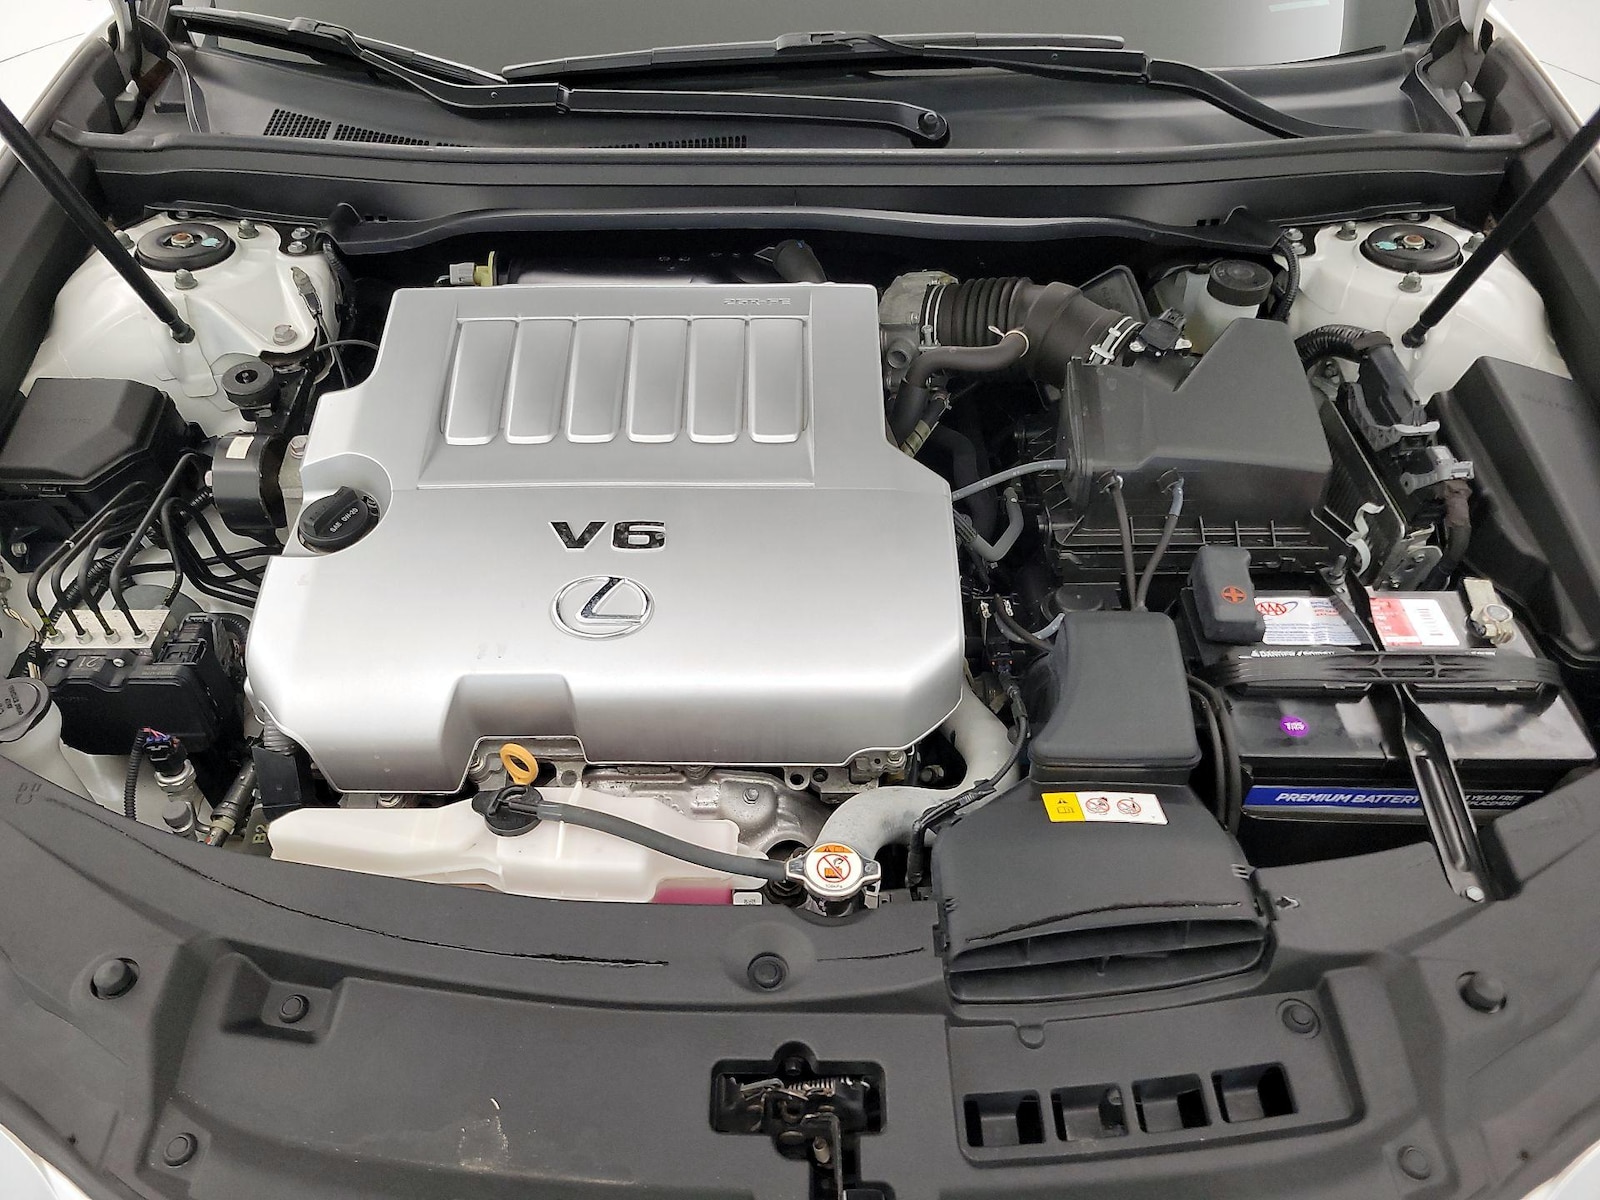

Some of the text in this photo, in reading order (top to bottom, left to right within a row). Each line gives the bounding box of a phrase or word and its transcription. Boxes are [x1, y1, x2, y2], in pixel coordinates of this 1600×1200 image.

[329, 521, 343, 534] SAE
[548, 520, 667, 551] V6
[1257, 601, 1287, 616] AAA
[1275, 792, 1420, 804] PREMIUM BATTERY
